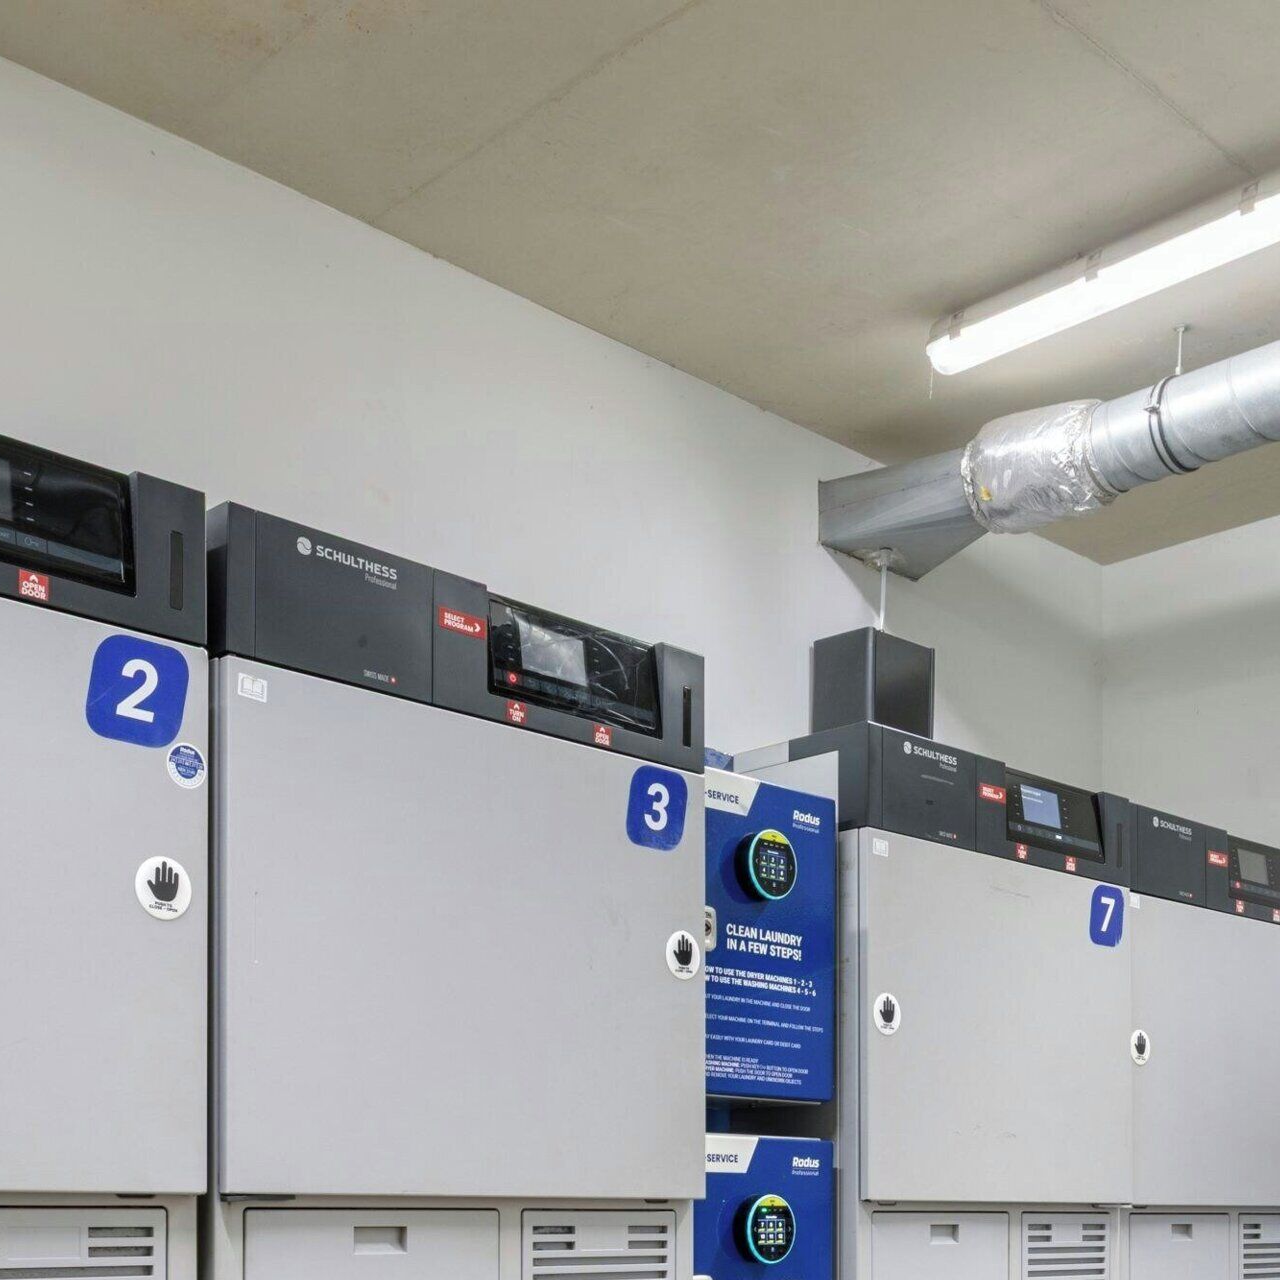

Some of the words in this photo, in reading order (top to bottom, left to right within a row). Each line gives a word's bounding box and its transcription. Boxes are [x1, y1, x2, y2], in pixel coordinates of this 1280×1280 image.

[316, 545, 398, 580] SCHULTHESS
[22, 580, 45, 593] OPEN
[365, 574, 397, 590] Professional
[22, 588, 46, 600] DOOR
[444, 612, 465, 623] SELECT
[444, 619, 473, 632] PROGRAM
[115, 658, 160, 723] 2
[913, 745, 958, 766] SCHULTHESS
[644, 783, 670, 831] 3
[793, 810, 820, 825] Rodus
[1160, 820, 1192, 836] SCHULTHESS
[1100, 897, 1115, 932] 7
[726, 924, 757, 939] CLEAN
[760, 929, 802, 946] LAUNDRY
[727, 938, 737, 950] IN
[739, 941, 746, 951] A
[748, 941, 767, 954] FEW
[770, 945, 801, 961] STEPS!
[724, 967, 734, 975] USE
[747, 971, 764, 980] DRYER
[766, 973, 792, 984] MACHINES
[792, 1156, 819, 1168] Rodus
